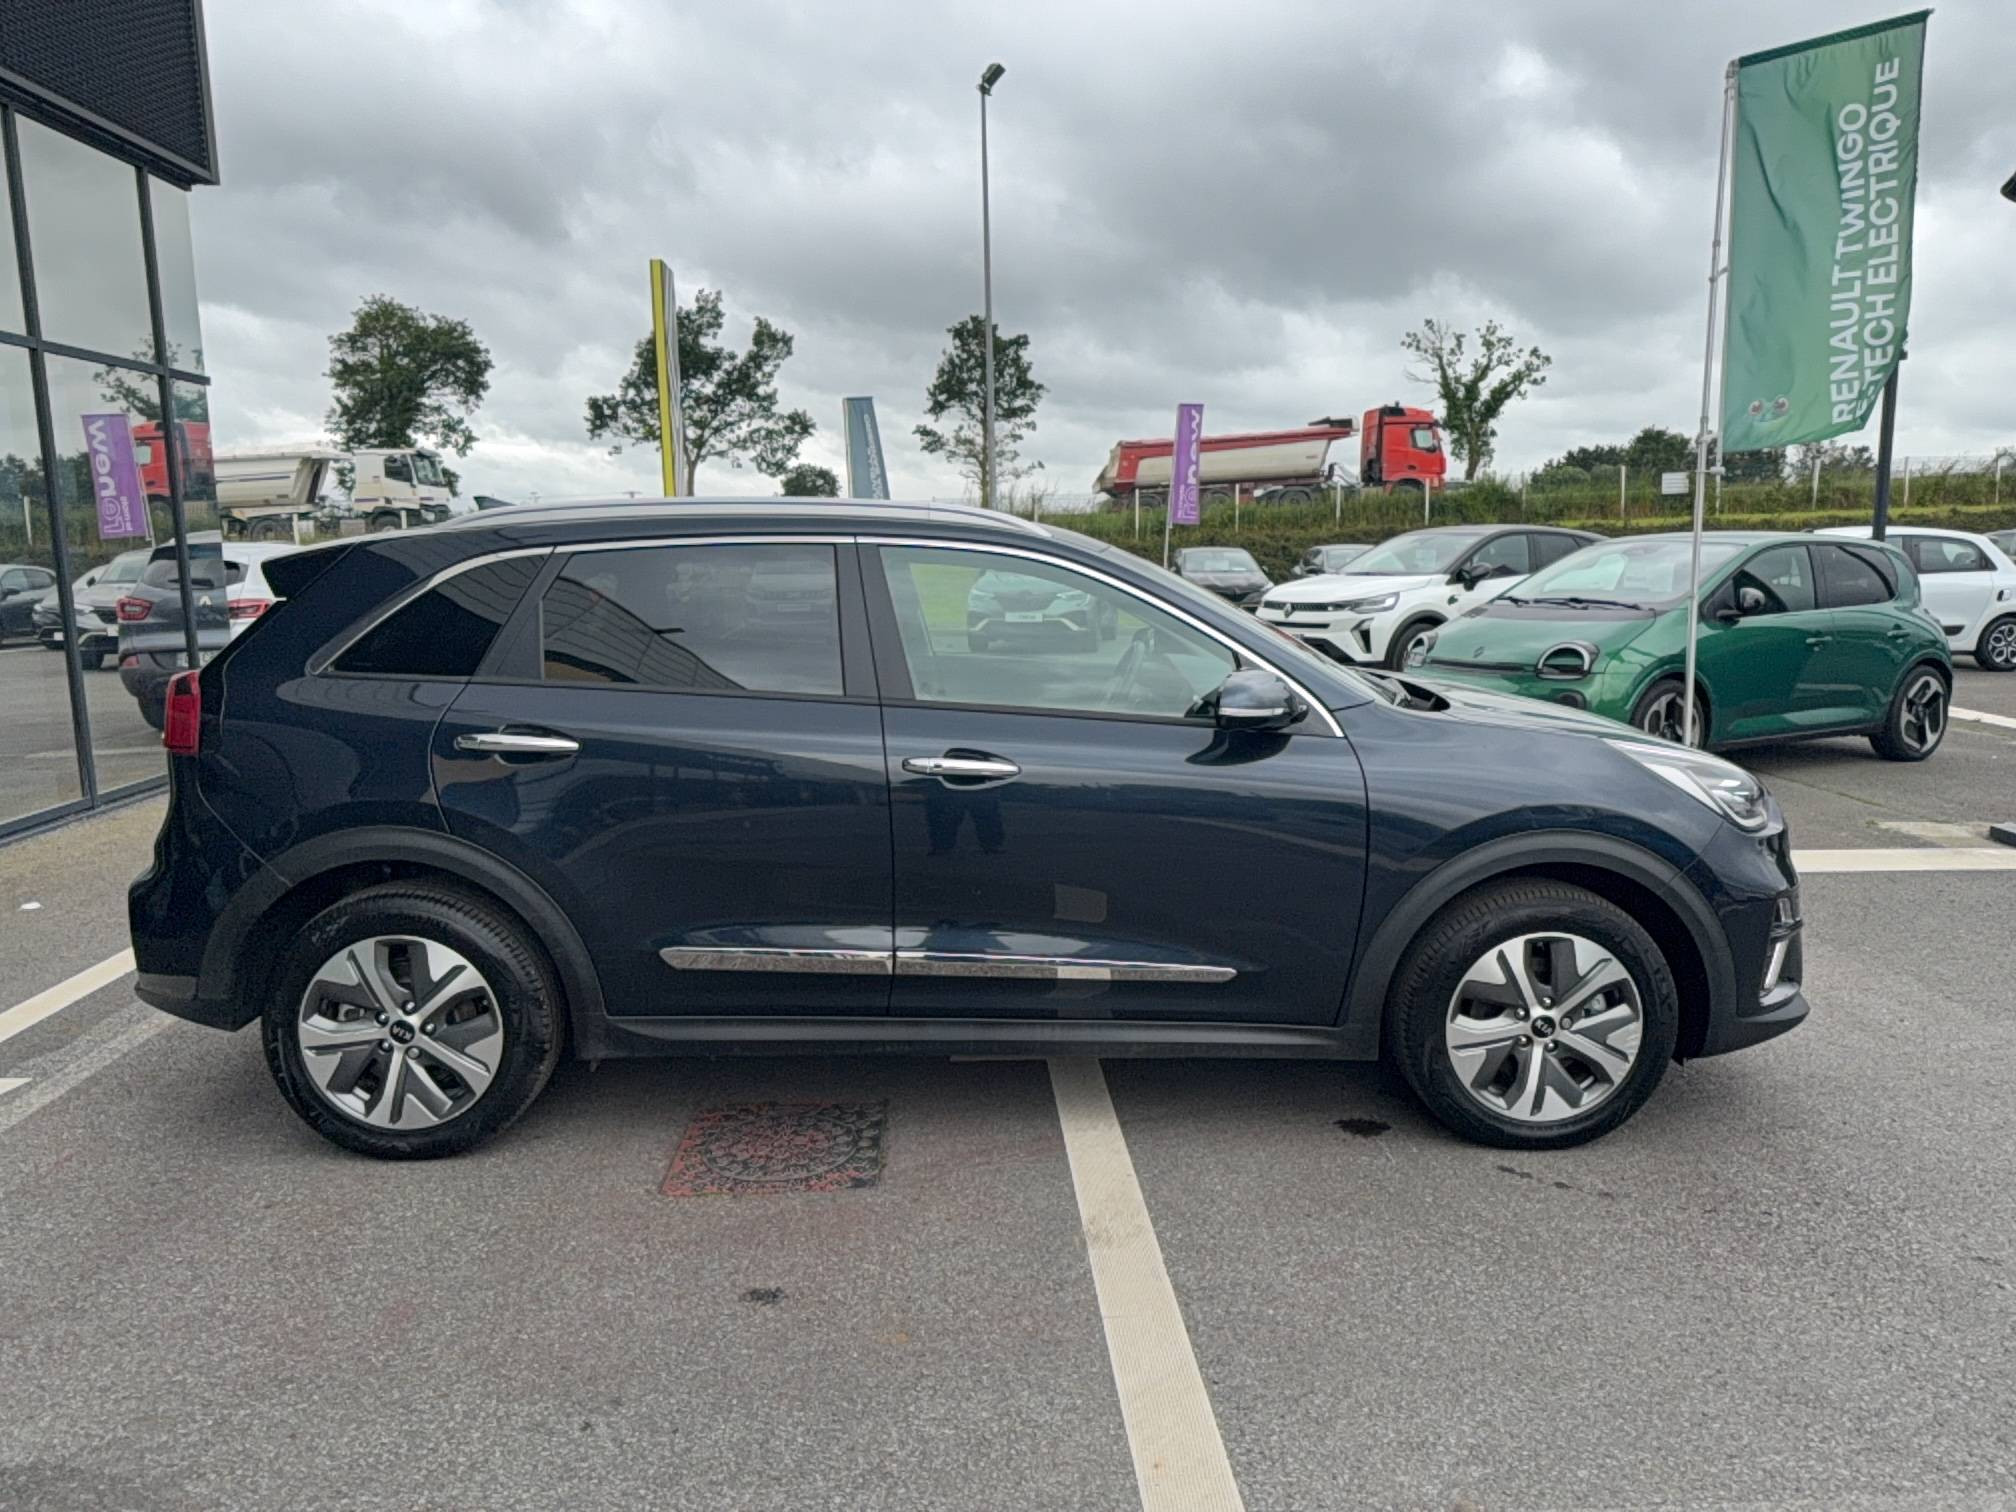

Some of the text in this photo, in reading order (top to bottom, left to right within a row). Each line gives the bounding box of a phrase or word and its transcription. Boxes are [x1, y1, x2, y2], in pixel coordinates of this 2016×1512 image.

[1829, 102, 1867, 424] RENAULT TWINGO
[1867, 57, 1901, 284] ELECTRIQUE
